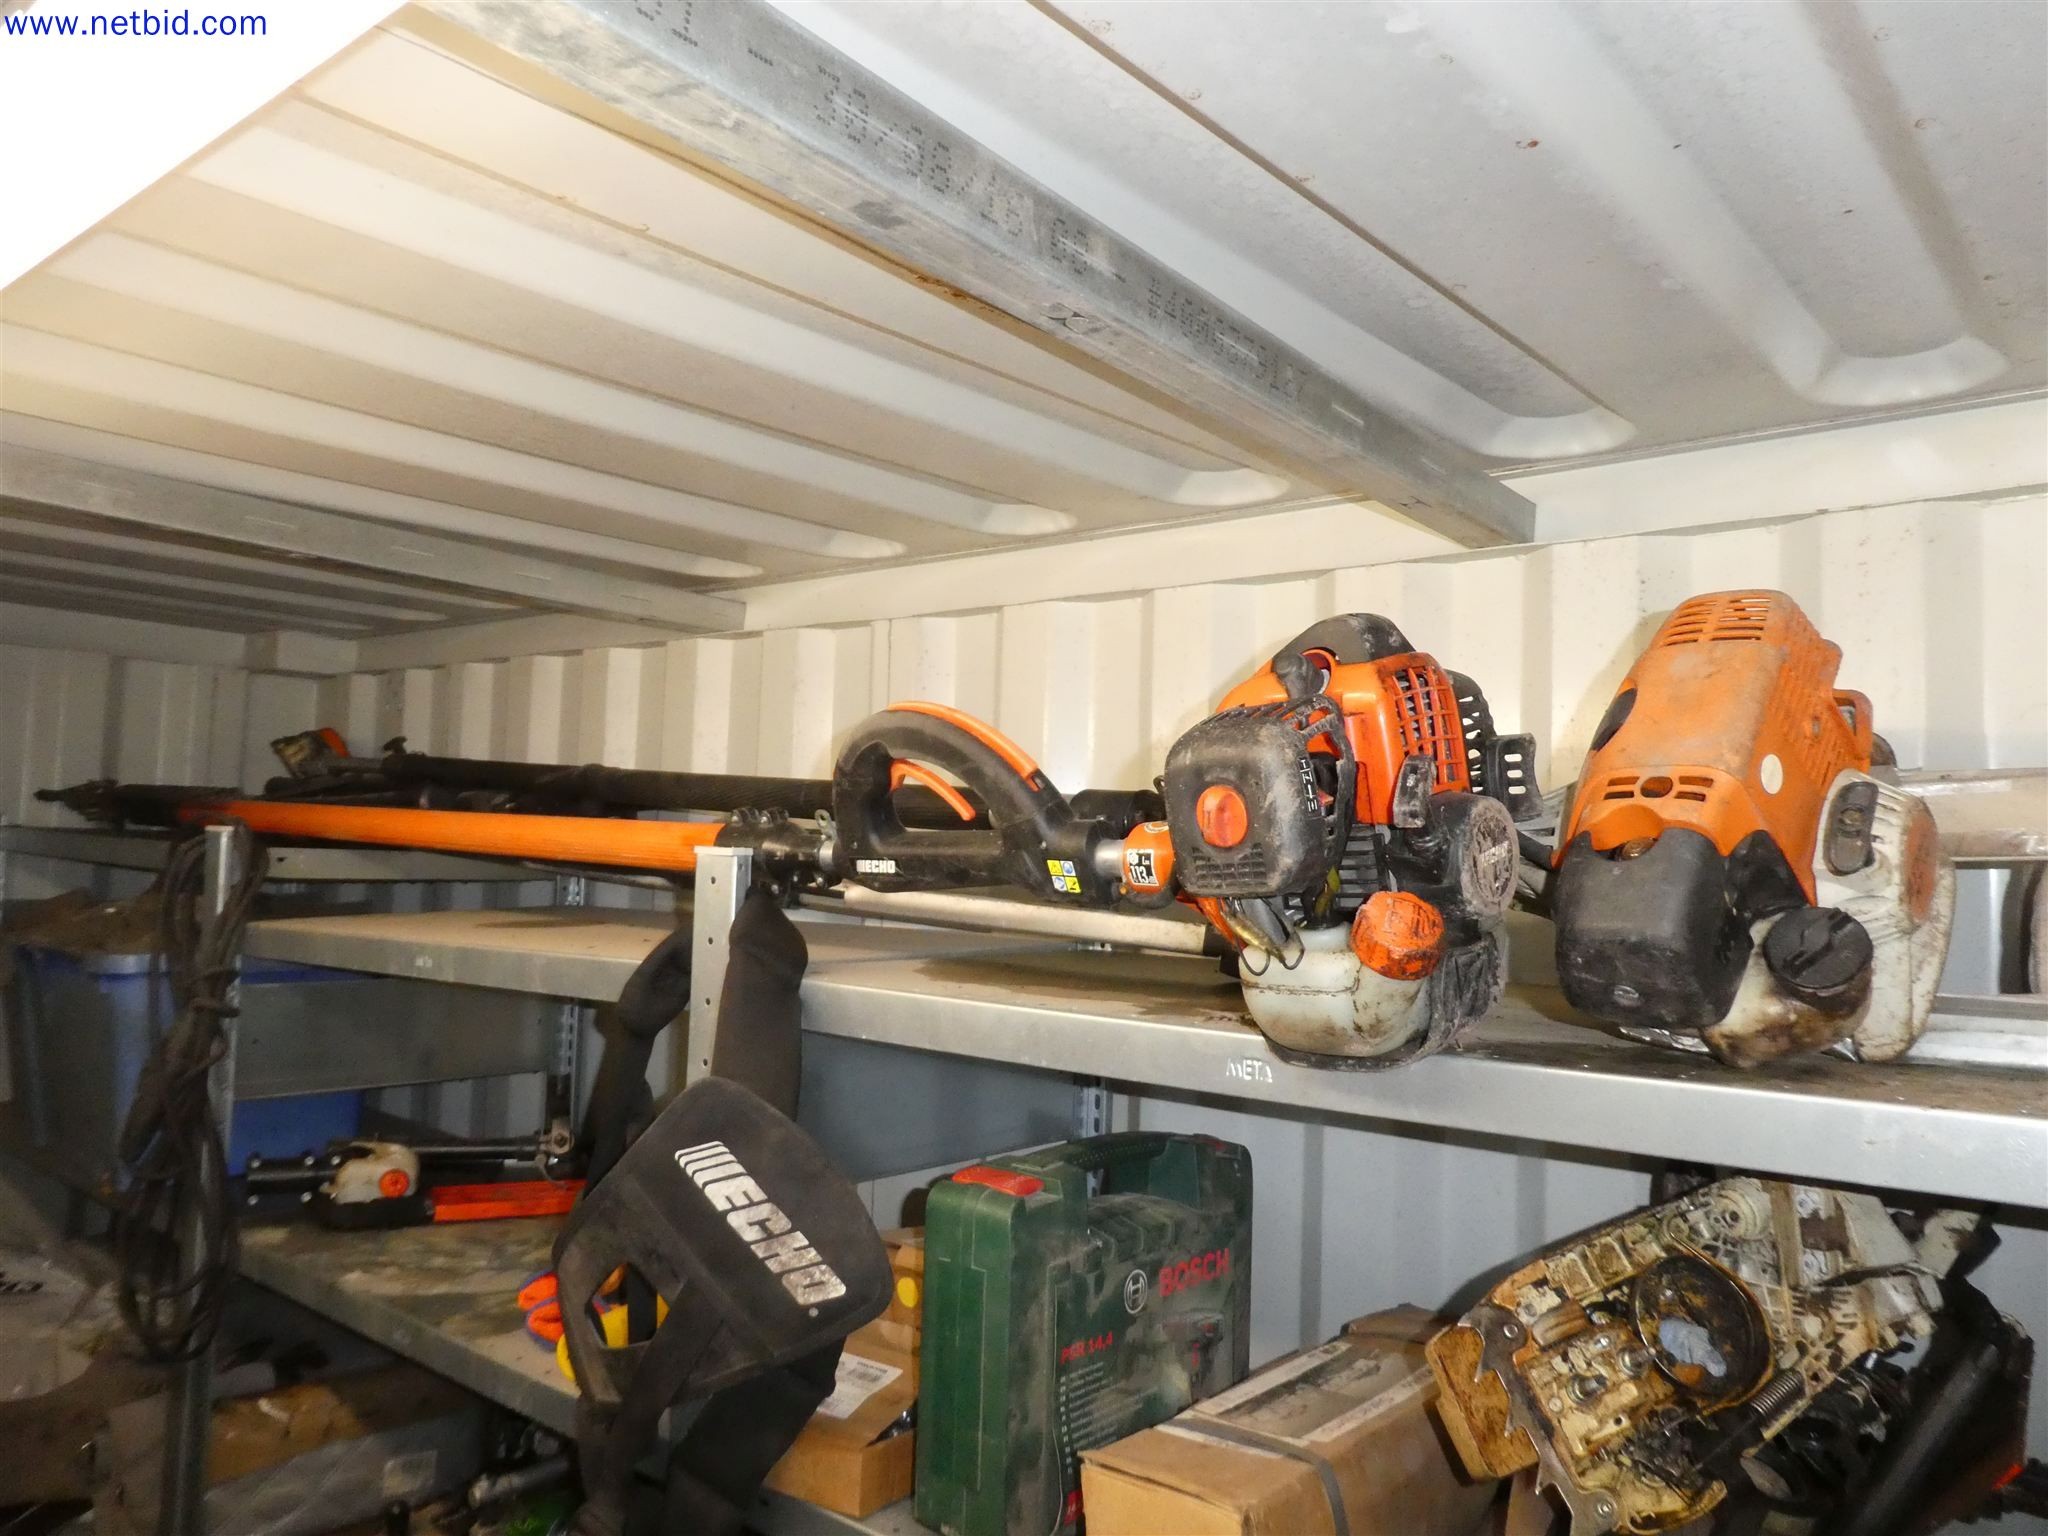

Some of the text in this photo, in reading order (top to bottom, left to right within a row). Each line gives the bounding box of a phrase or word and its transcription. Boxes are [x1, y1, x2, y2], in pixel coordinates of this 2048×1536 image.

[856, 859, 896, 874] ECHO
[1130, 865, 1149, 884] 113
[675, 1141, 847, 1306] ECHO
[1158, 1248, 1231, 1298] BOSCH
